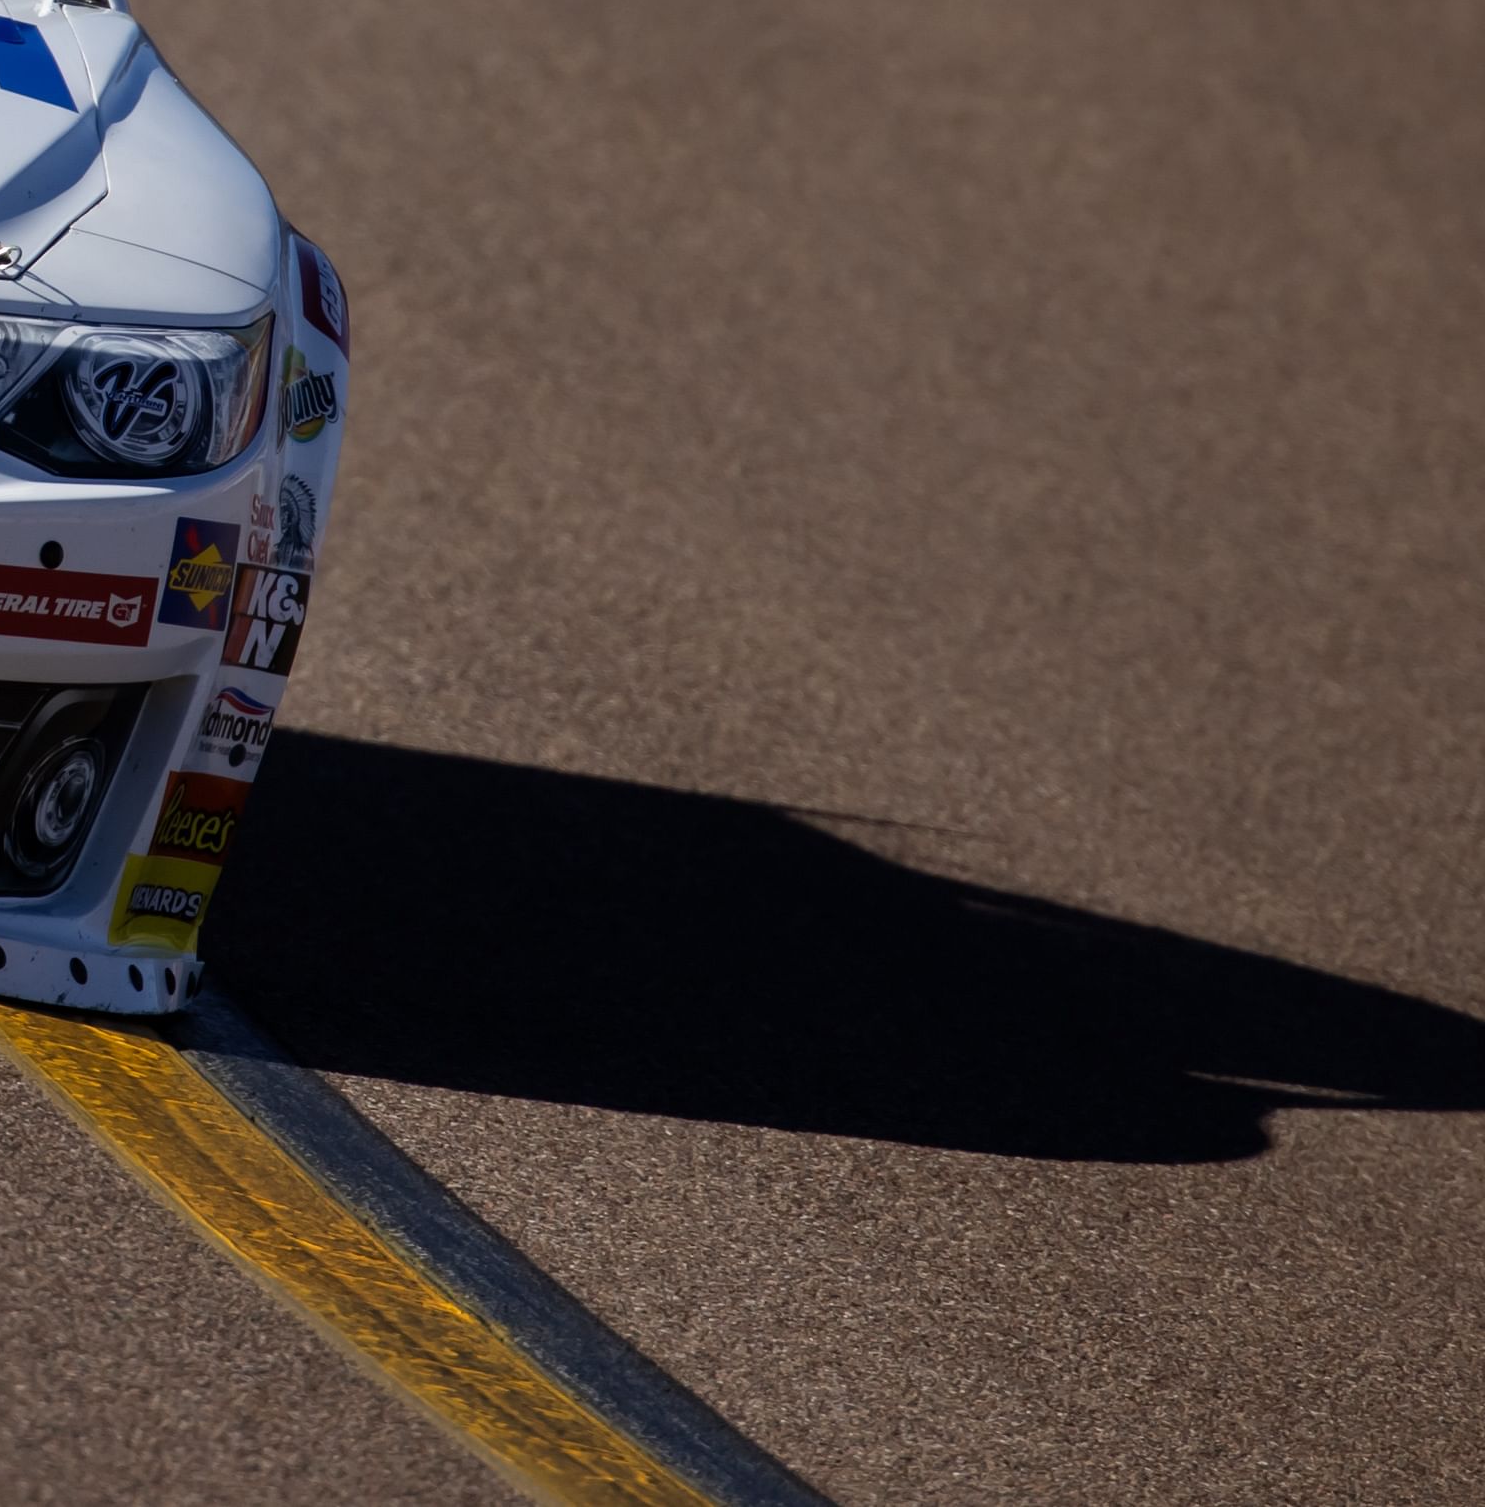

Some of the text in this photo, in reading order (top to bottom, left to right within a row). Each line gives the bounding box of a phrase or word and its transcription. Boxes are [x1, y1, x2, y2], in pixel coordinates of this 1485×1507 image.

[172, 562, 232, 592] SUNOCO
[52, 597, 107, 620] TIRE
[131, 885, 203, 919] MENARDS
